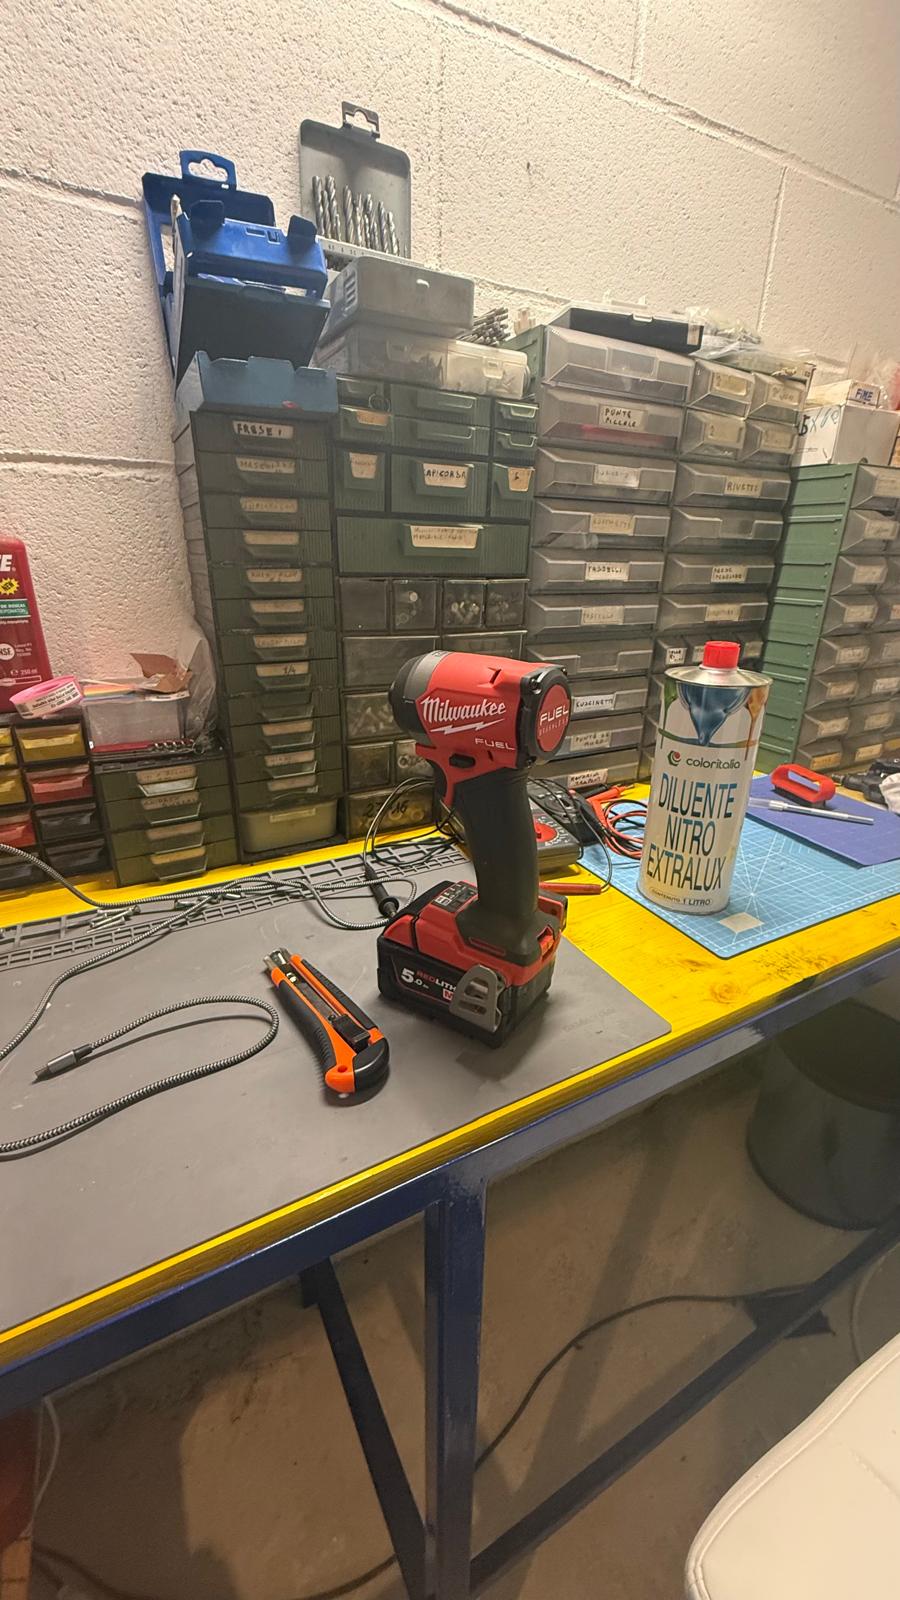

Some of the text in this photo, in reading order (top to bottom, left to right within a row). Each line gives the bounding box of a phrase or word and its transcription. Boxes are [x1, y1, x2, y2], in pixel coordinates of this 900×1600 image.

[605, 407, 632, 418] PUNTE
[0, 554, 12, 571] E
[420, 695, 507, 725] Milwaukee
[539, 705, 570, 727] FUEL
[475, 738, 516, 750] FUEL
[685, 757, 741, 770] coloritalia
[658, 772, 738, 819] DILUENTE
[664, 814, 716, 857] NITRO
[647, 843, 727, 892] EXTRALUX
[688, 898, 711, 907] LITRO
[400, 967, 423, 987] 5.0
